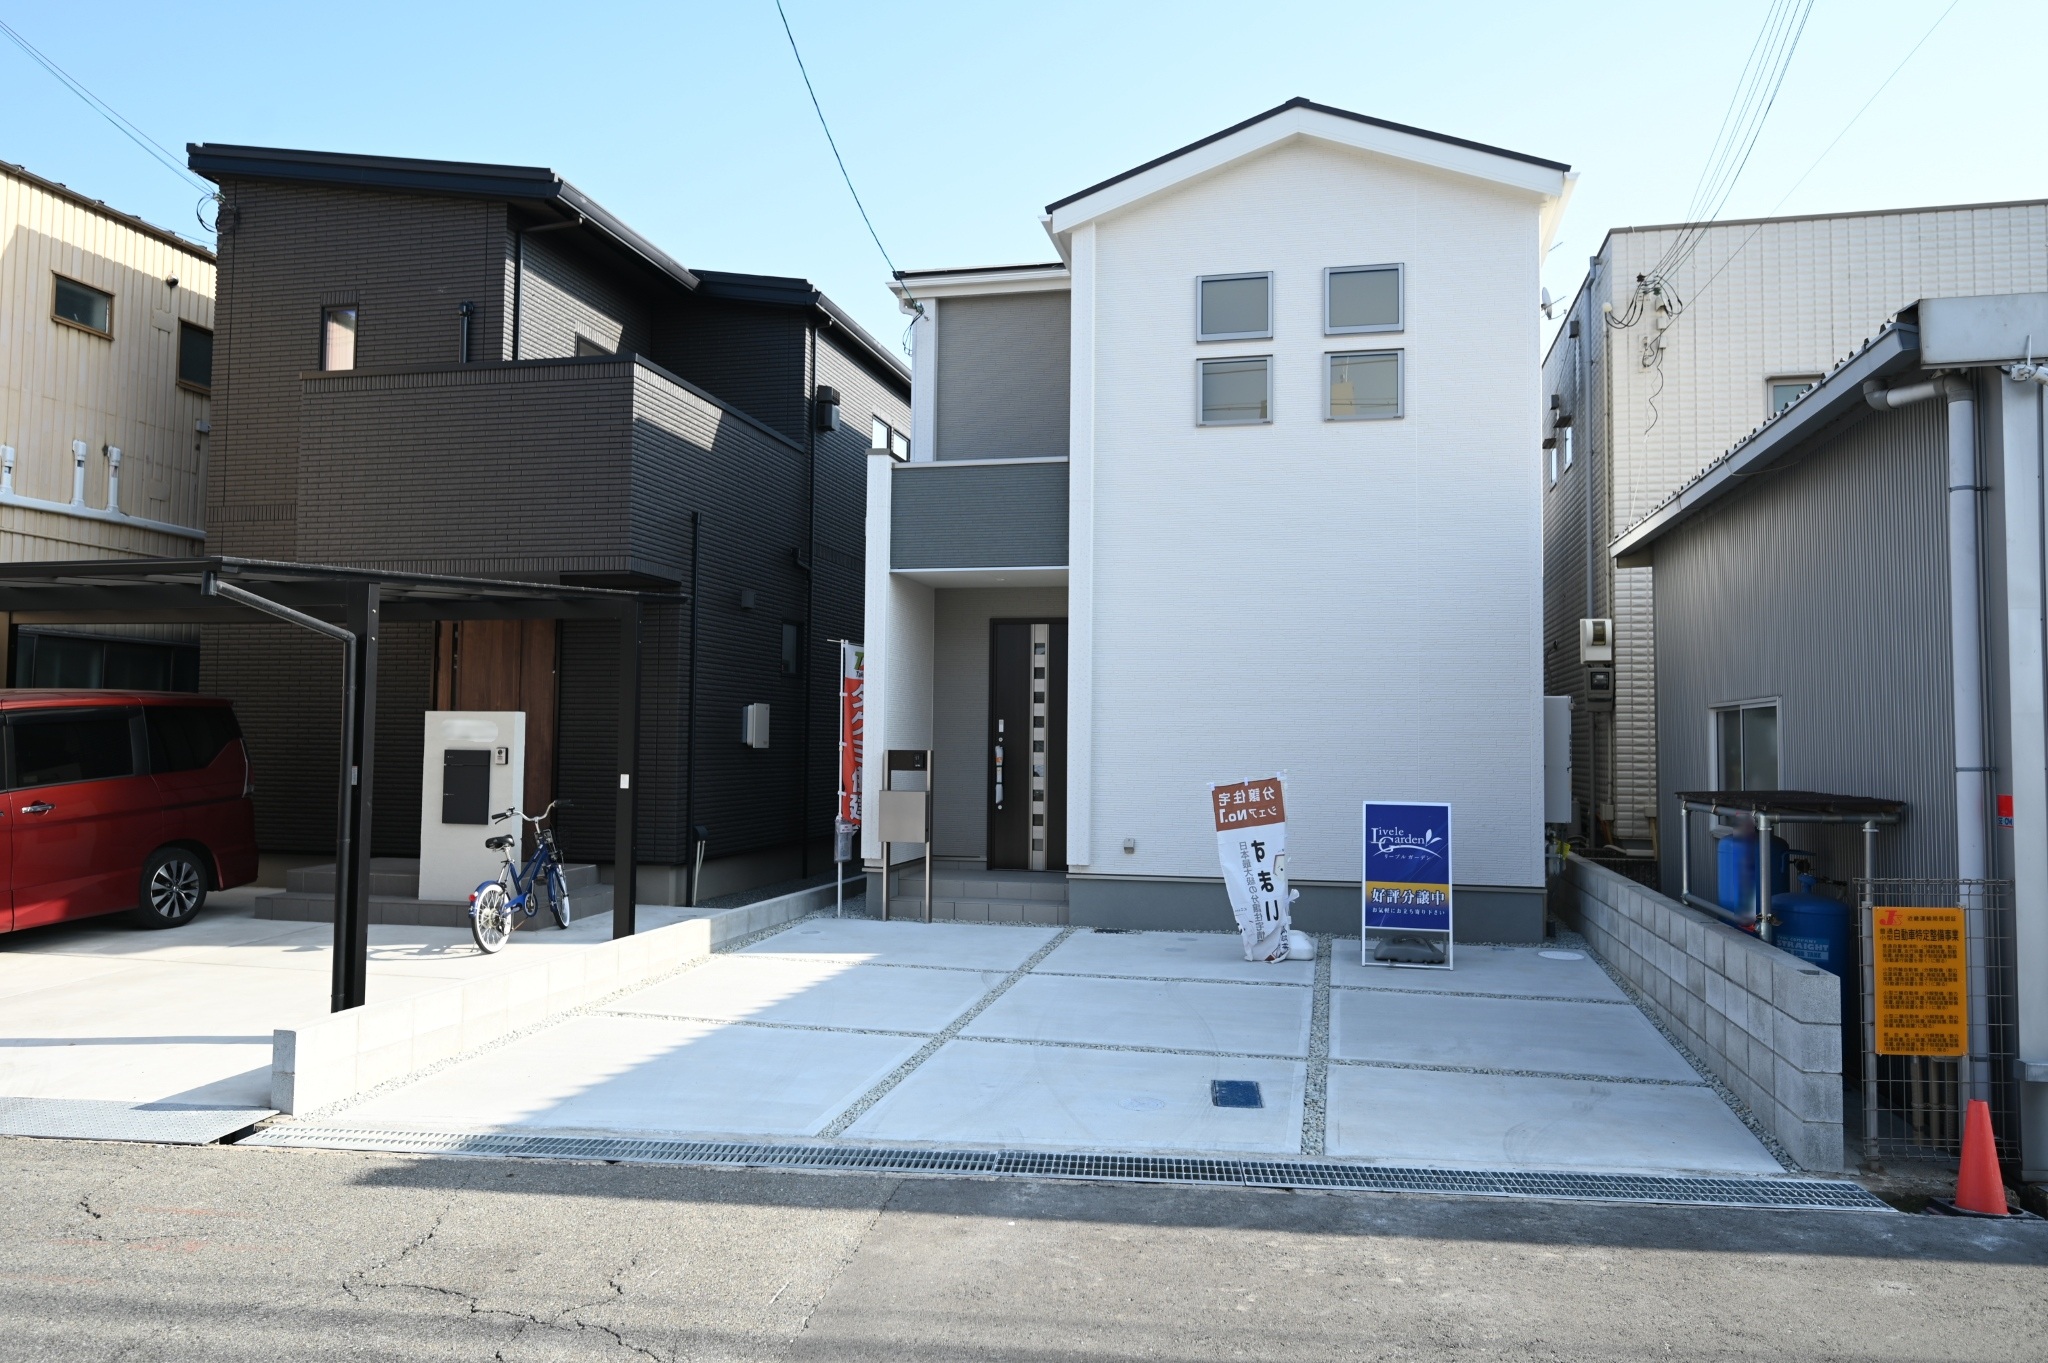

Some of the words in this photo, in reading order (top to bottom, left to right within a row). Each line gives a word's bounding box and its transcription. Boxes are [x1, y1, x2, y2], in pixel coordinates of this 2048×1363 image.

[1371, 827, 1404, 844] Livele
[1378, 834, 1425, 853] Garden
[1372, 888, 1445, 905] 好評分譲中
[1372, 906, 1445, 916] お気軽にお立ち寄り下さい
[1893, 929, 1959, 941] 自動車特定整備事業
[1777, 940, 1829, 951] STRAIGHT
